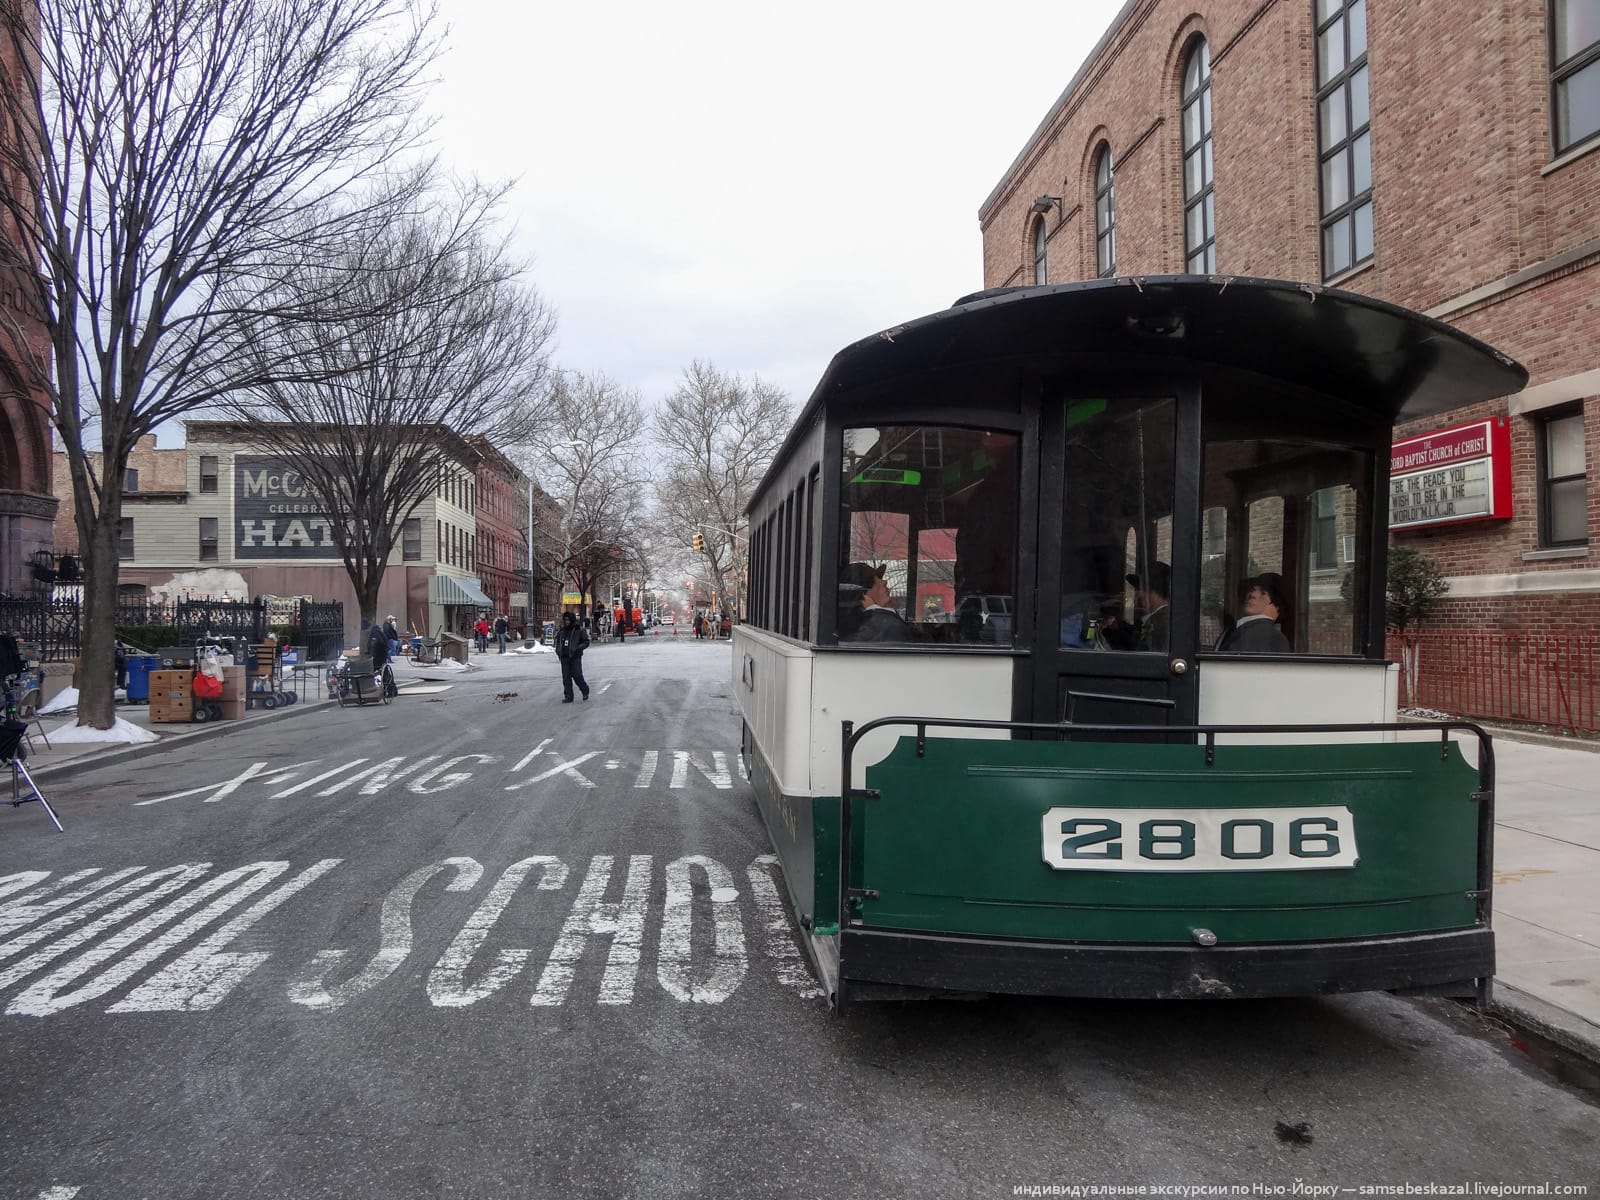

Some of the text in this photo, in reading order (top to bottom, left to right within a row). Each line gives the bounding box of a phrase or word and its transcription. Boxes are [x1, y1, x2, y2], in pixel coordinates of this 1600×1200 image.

[1405, 451, 1427, 467] BAPTIST
[1428, 444, 1453, 462] CHURCH
[1454, 443, 1460, 456] of
[1461, 437, 1485, 454] CHRIST
[1408, 478, 1420, 491] THE
[1423, 471, 1446, 488] PEACE
[1450, 468, 1465, 482] YOU
[268, 503, 351, 514] CELEBRAD
[1392, 484, 1465, 508] WISH TO SEE IN THE
[504, 750, 751, 791] X-IN
[1061, 817, 1341, 860] 2806
